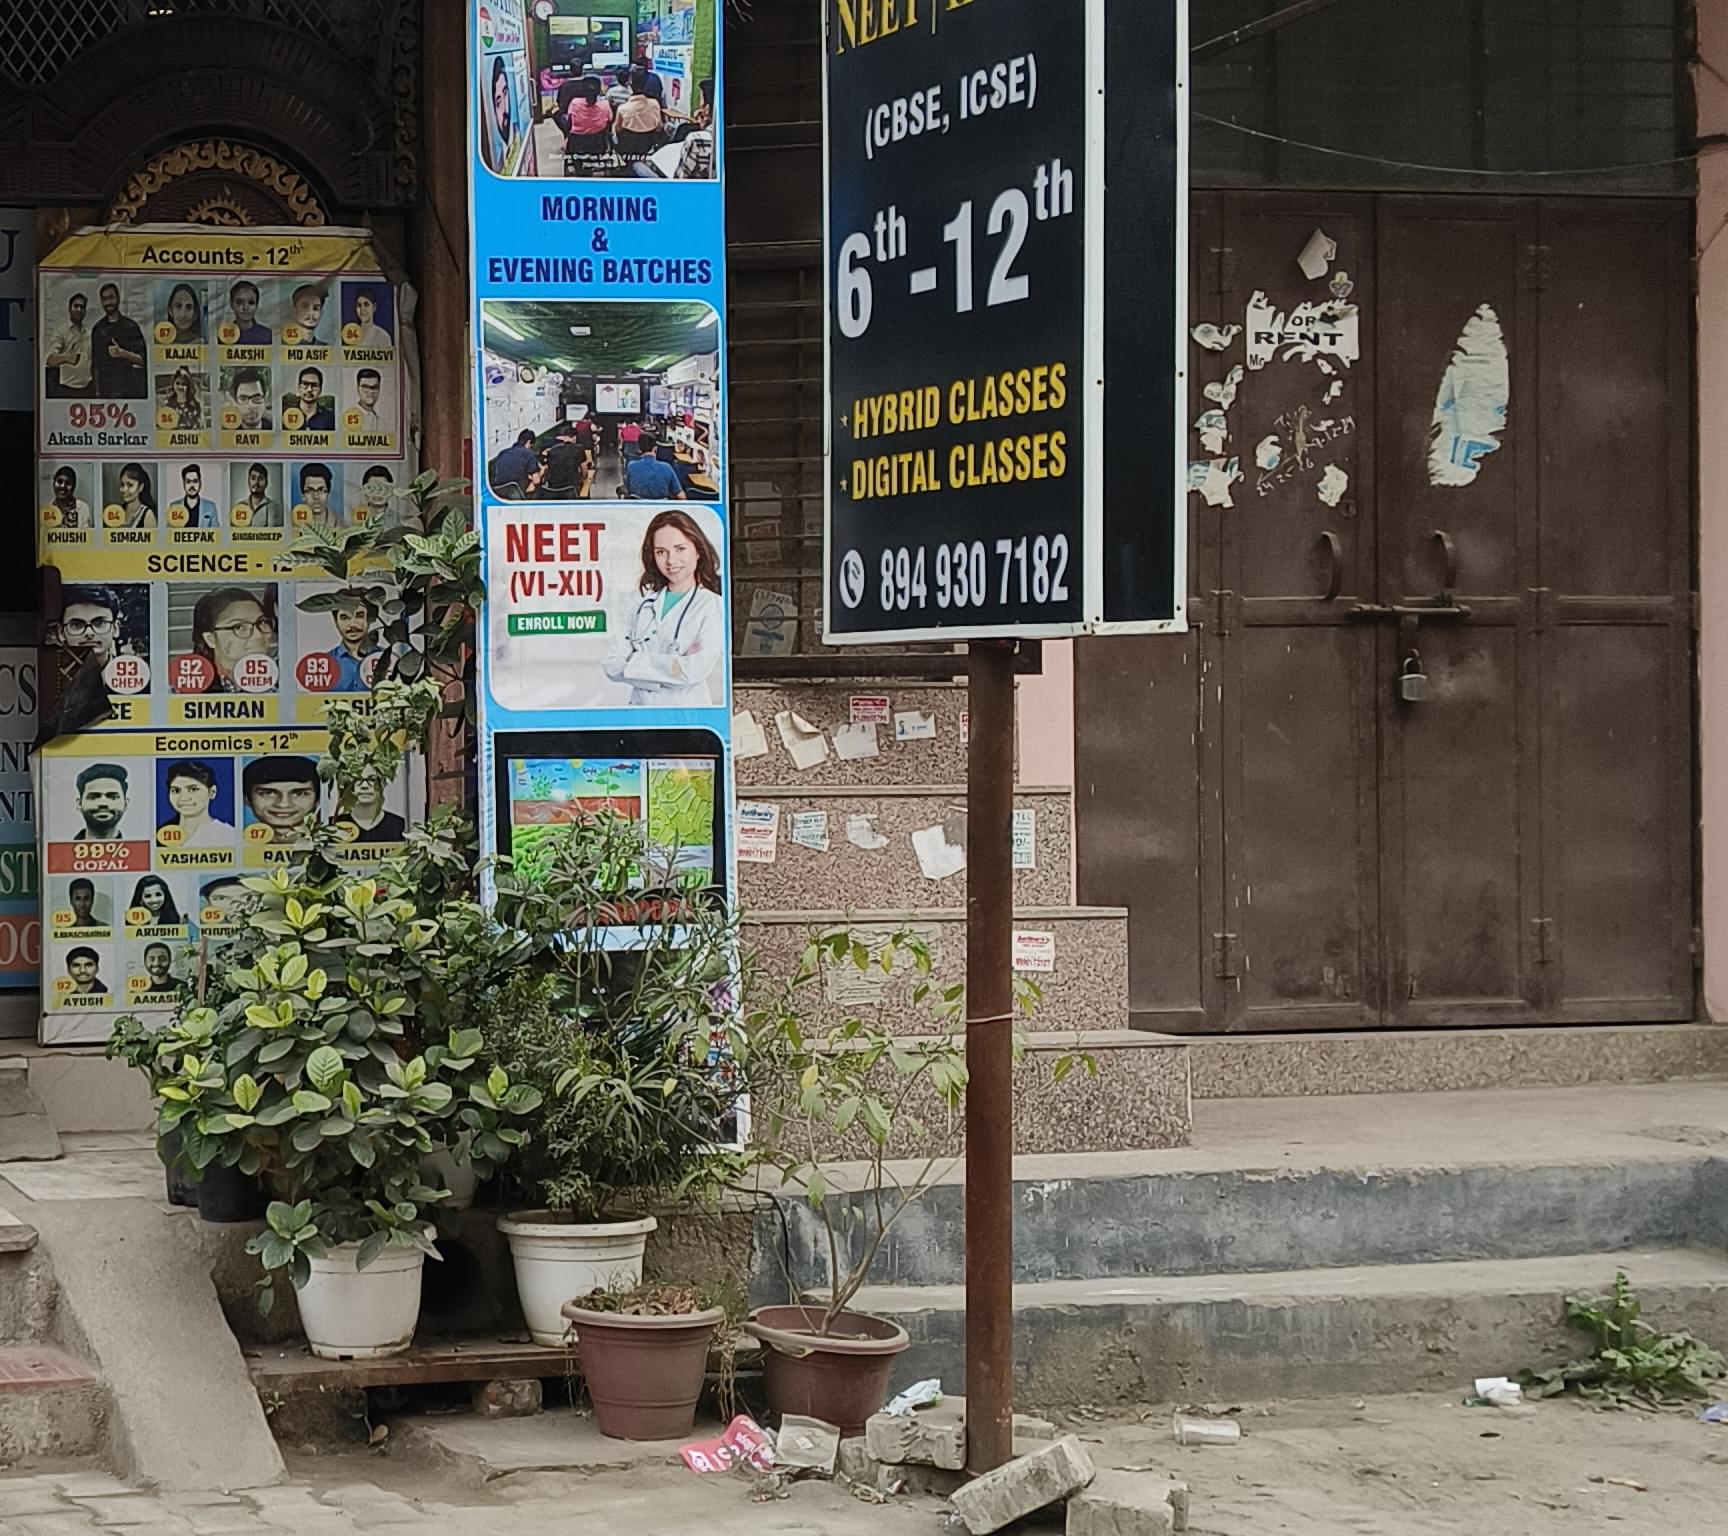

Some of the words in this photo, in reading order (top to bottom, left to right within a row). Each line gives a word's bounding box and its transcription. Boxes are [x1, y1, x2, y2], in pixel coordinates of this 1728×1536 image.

[864, 85, 951, 160] (CBSE,
[960, 52, 1038, 121] ICSE)
[542, 195, 658, 222] MORNING
[591, 227, 610, 252] &
[142, 244, 245, 266] Accounts
[488, 257, 593, 284] EVENING
[603, 258, 712, 284] BATCHES
[852, 385, 941, 440] HYBRID
[949, 362, 1067, 425] CLASSES
[47, 431, 94, 447] Akash
[97, 431, 149, 447] Sarkar
[852, 449, 941, 501] DIGITAL
[949, 430, 1067, 490] CLASSES
[505, 522, 606, 563] NEET
[147, 554, 248, 573] SCIENCE
[879, 545, 928, 612] 894
[936, 539, 987, 609] 930
[995, 532, 1070, 605] 7182
[510, 569, 604, 604] (VI-XII)
[517, 615, 564, 631] ENROLL
[567, 614, 597, 630] NOW
[115, 660, 138, 677] 93
[179, 659, 203, 675] 92
[306, 658, 329, 673] 93
[184, 700, 265, 720] SIMRAN
[155, 736, 254, 752] Economics
[73, 859, 129, 872] GOPAL
[160, 852, 234, 864] YASHASVI
